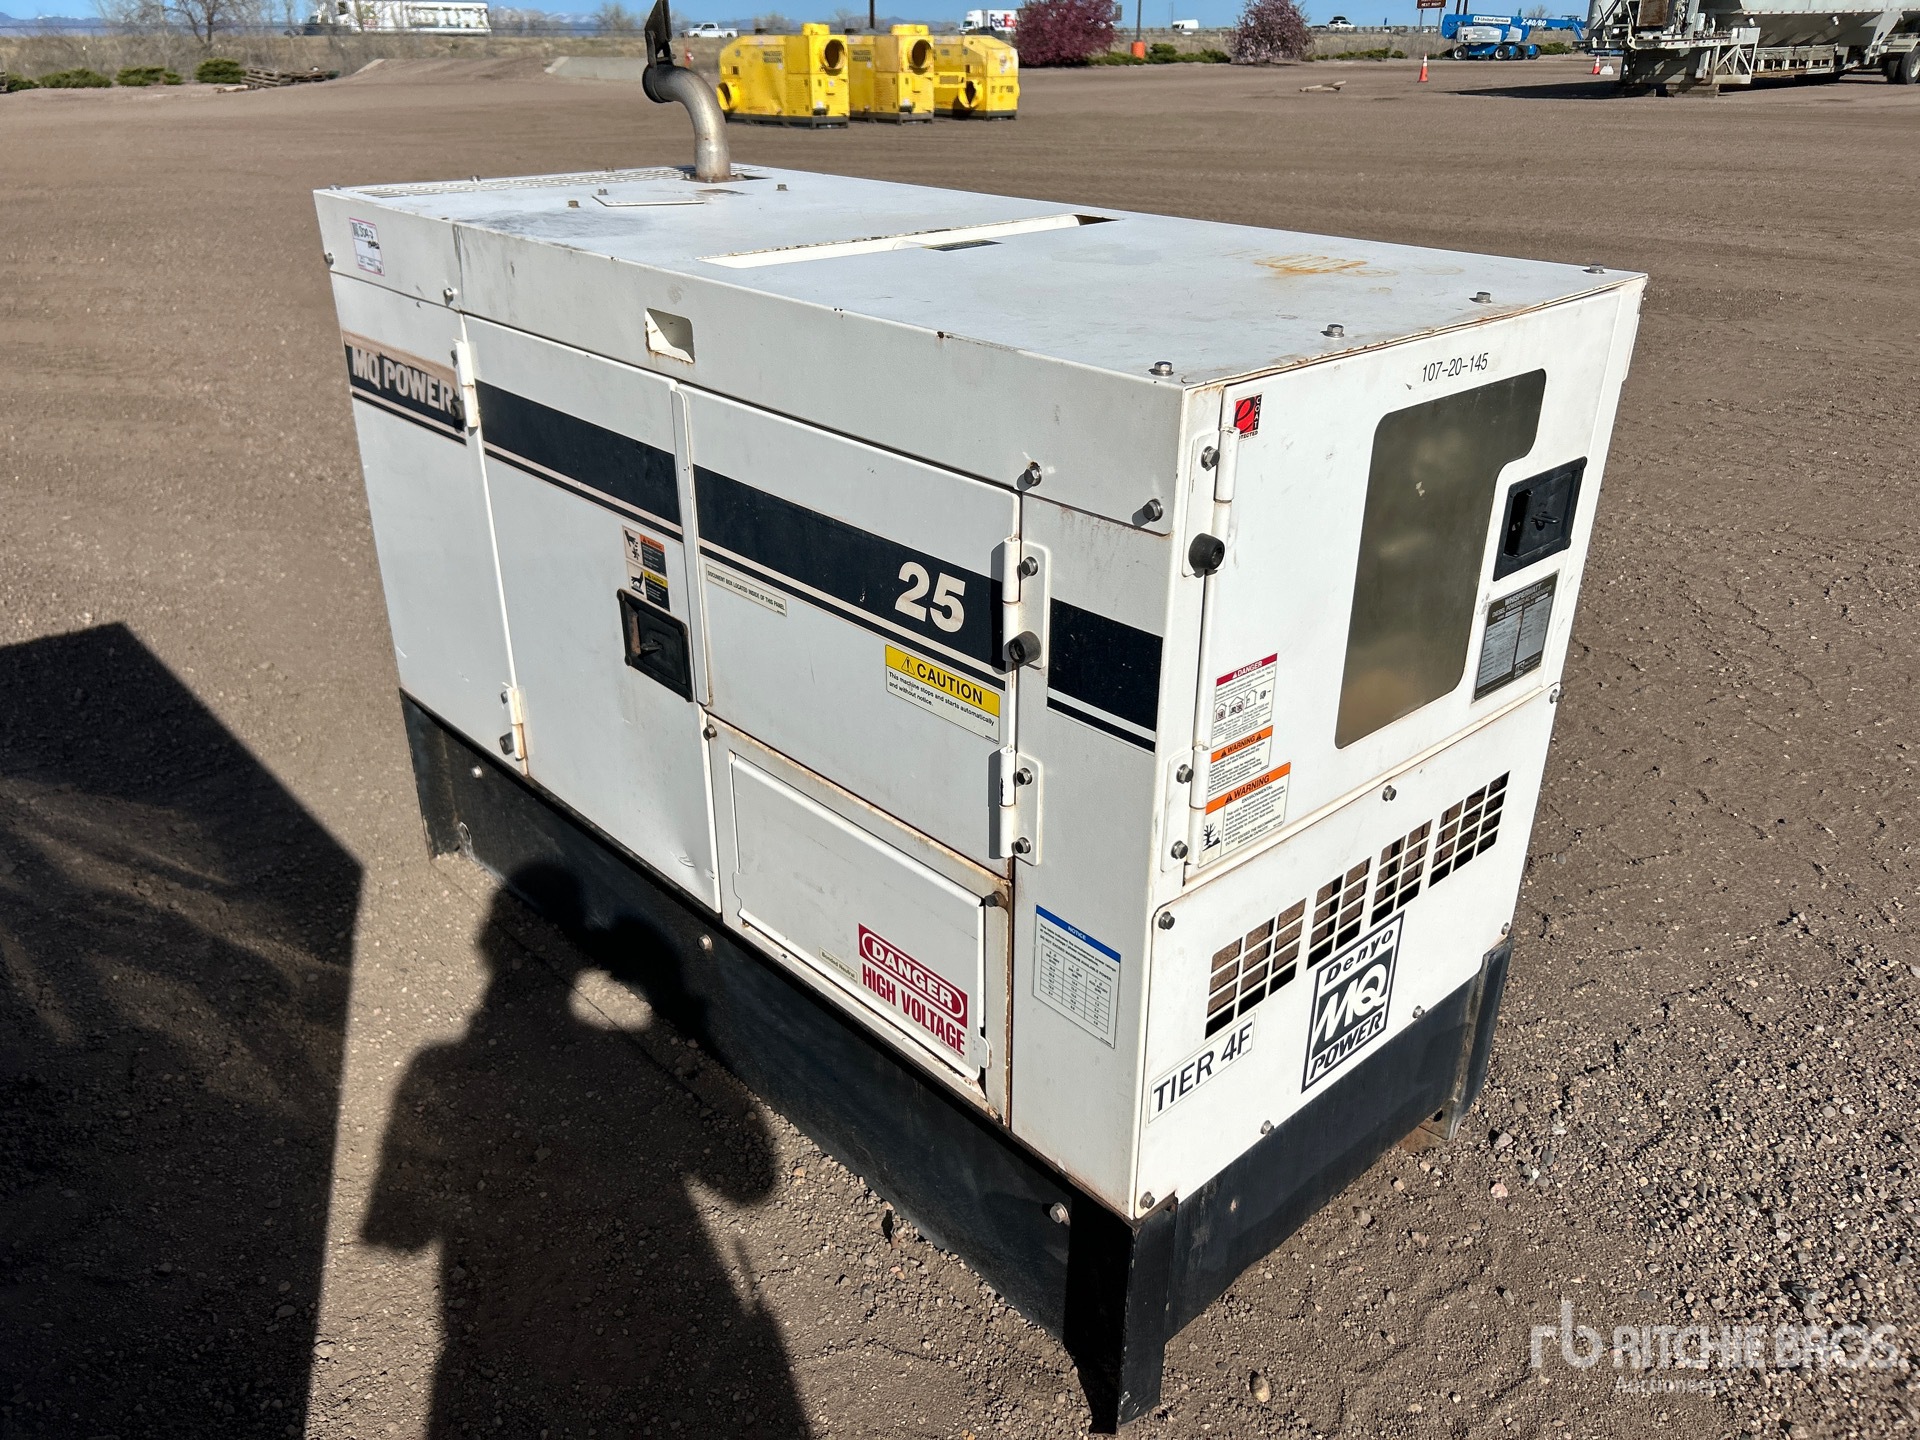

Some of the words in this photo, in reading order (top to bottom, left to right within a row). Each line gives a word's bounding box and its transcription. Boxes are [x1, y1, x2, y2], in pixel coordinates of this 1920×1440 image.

[352, 346, 381, 390] MQ
[383, 358, 453, 416] POWER
[1423, 352, 1489, 382] 107-20-145
[894, 561, 967, 633] 25
[889, 681, 898, 690] and
[899, 685, 916, 699] without
[917, 663, 983, 705] CAUTION
[1237, 660, 1262, 676] DANGER
[889, 671, 899, 681] This
[900, 676, 920, 691] machine
[920, 687, 934, 698] stops
[935, 693, 945, 702] and
[945, 697, 960, 709] starts
[960, 704, 995, 727] automatically
[1227, 734, 1255, 753] WARNING
[1233, 774, 1269, 799] WARNING
[1067, 925, 1086, 941] NOTICE
[1324, 929, 1394, 987] Denyo
[872, 941, 953, 1010] DANGER
[862, 963, 897, 1007] HIGH
[901, 989, 966, 1056] VOLTAGE
[1311, 963, 1387, 1052] MQ
[1153, 1050, 1214, 1113] TIER
[1221, 1021, 1253, 1063] 4F
[1309, 1011, 1383, 1081] POWER
